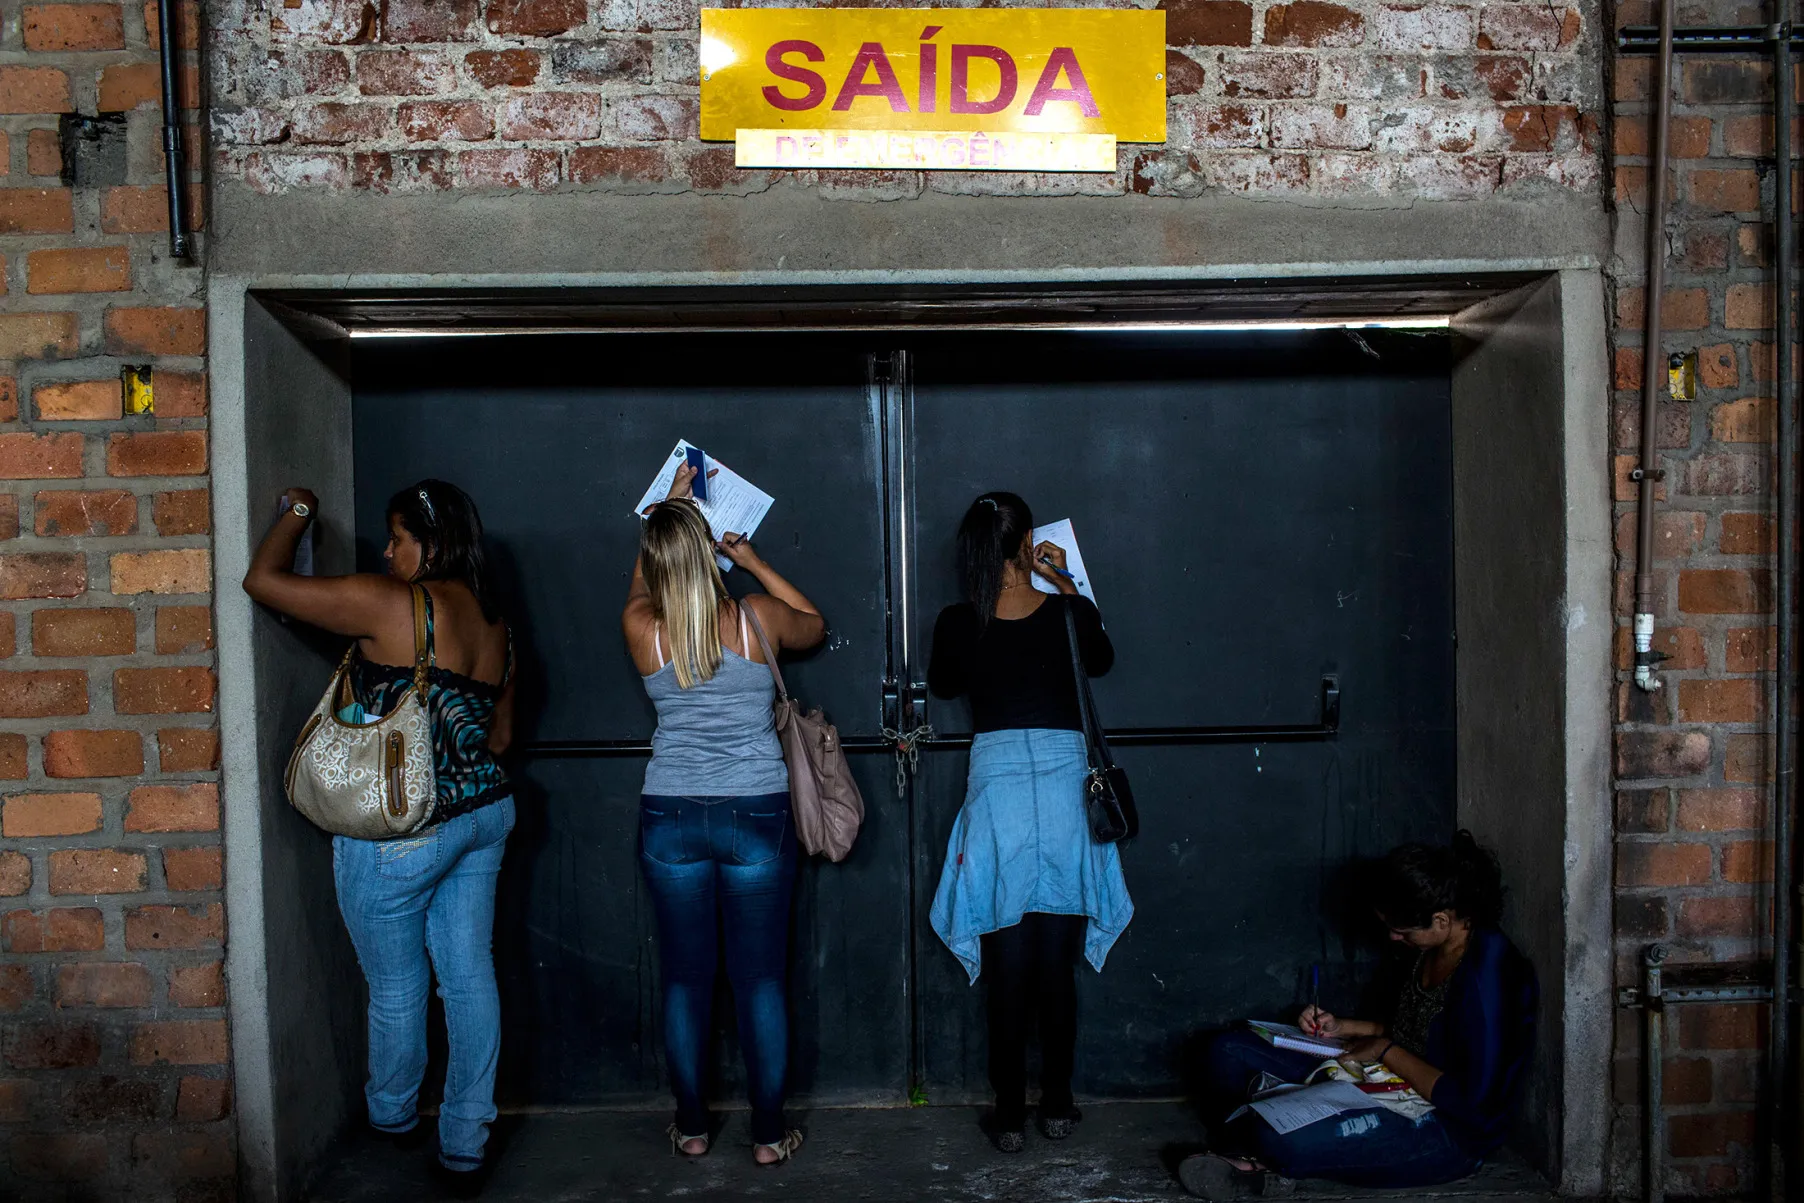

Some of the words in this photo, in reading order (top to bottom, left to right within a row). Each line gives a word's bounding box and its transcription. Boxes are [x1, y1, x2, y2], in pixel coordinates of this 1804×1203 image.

[761, 26, 1101, 118] SAÍDA
[776, 136, 821, 163] DE
[835, 131, 1075, 166] EMERGÊN
